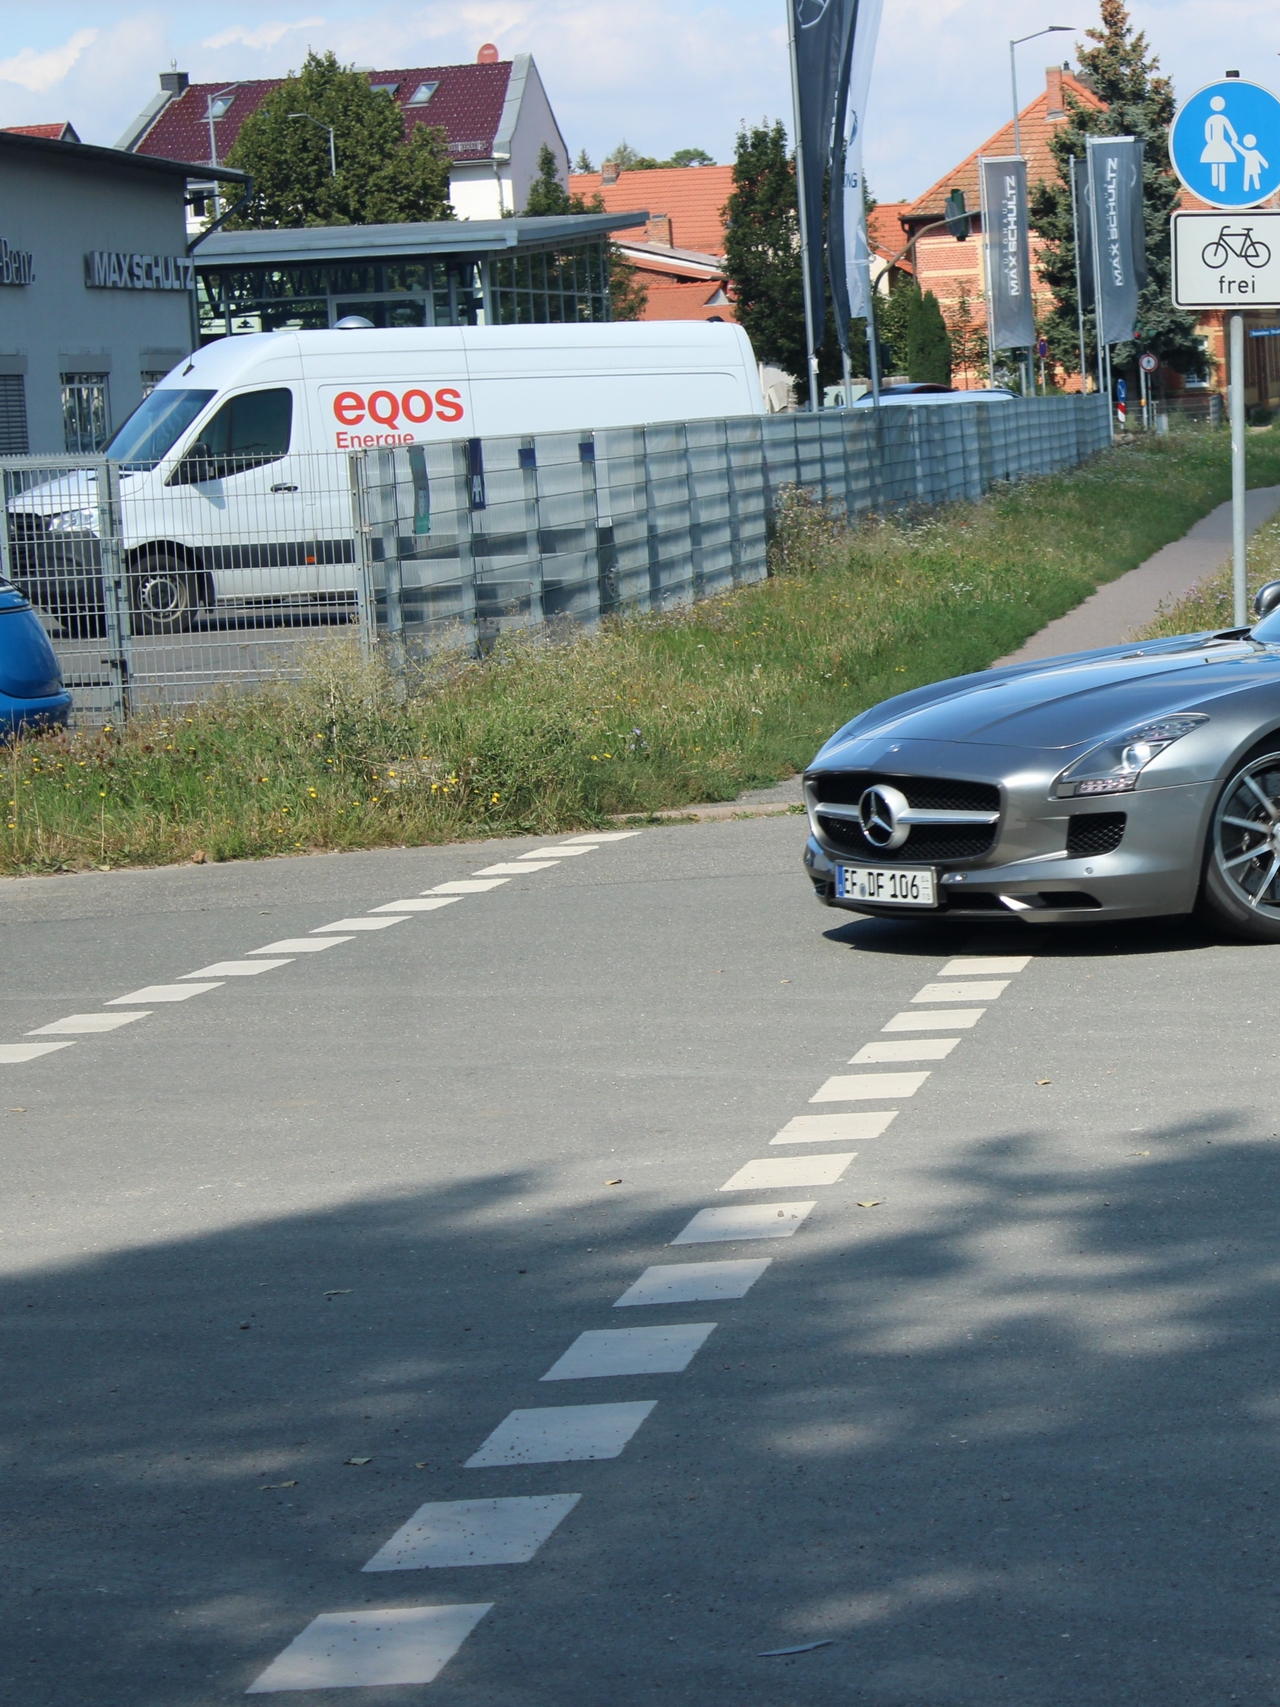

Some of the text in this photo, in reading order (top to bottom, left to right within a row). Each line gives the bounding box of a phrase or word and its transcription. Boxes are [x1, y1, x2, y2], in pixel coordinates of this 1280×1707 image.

[1002, 200, 1010, 274] AUTOHAUS
[1005, 176, 1020, 296] MAX SCHULTZ
[1106, 157, 1124, 286] MAX SCHULTZ
[93, 251, 195, 290] MAX SCHULTZ
[1218, 275, 1255, 294] frei
[336, 431, 415, 448] Energie
[844, 869, 919, 899] EF DF 106
